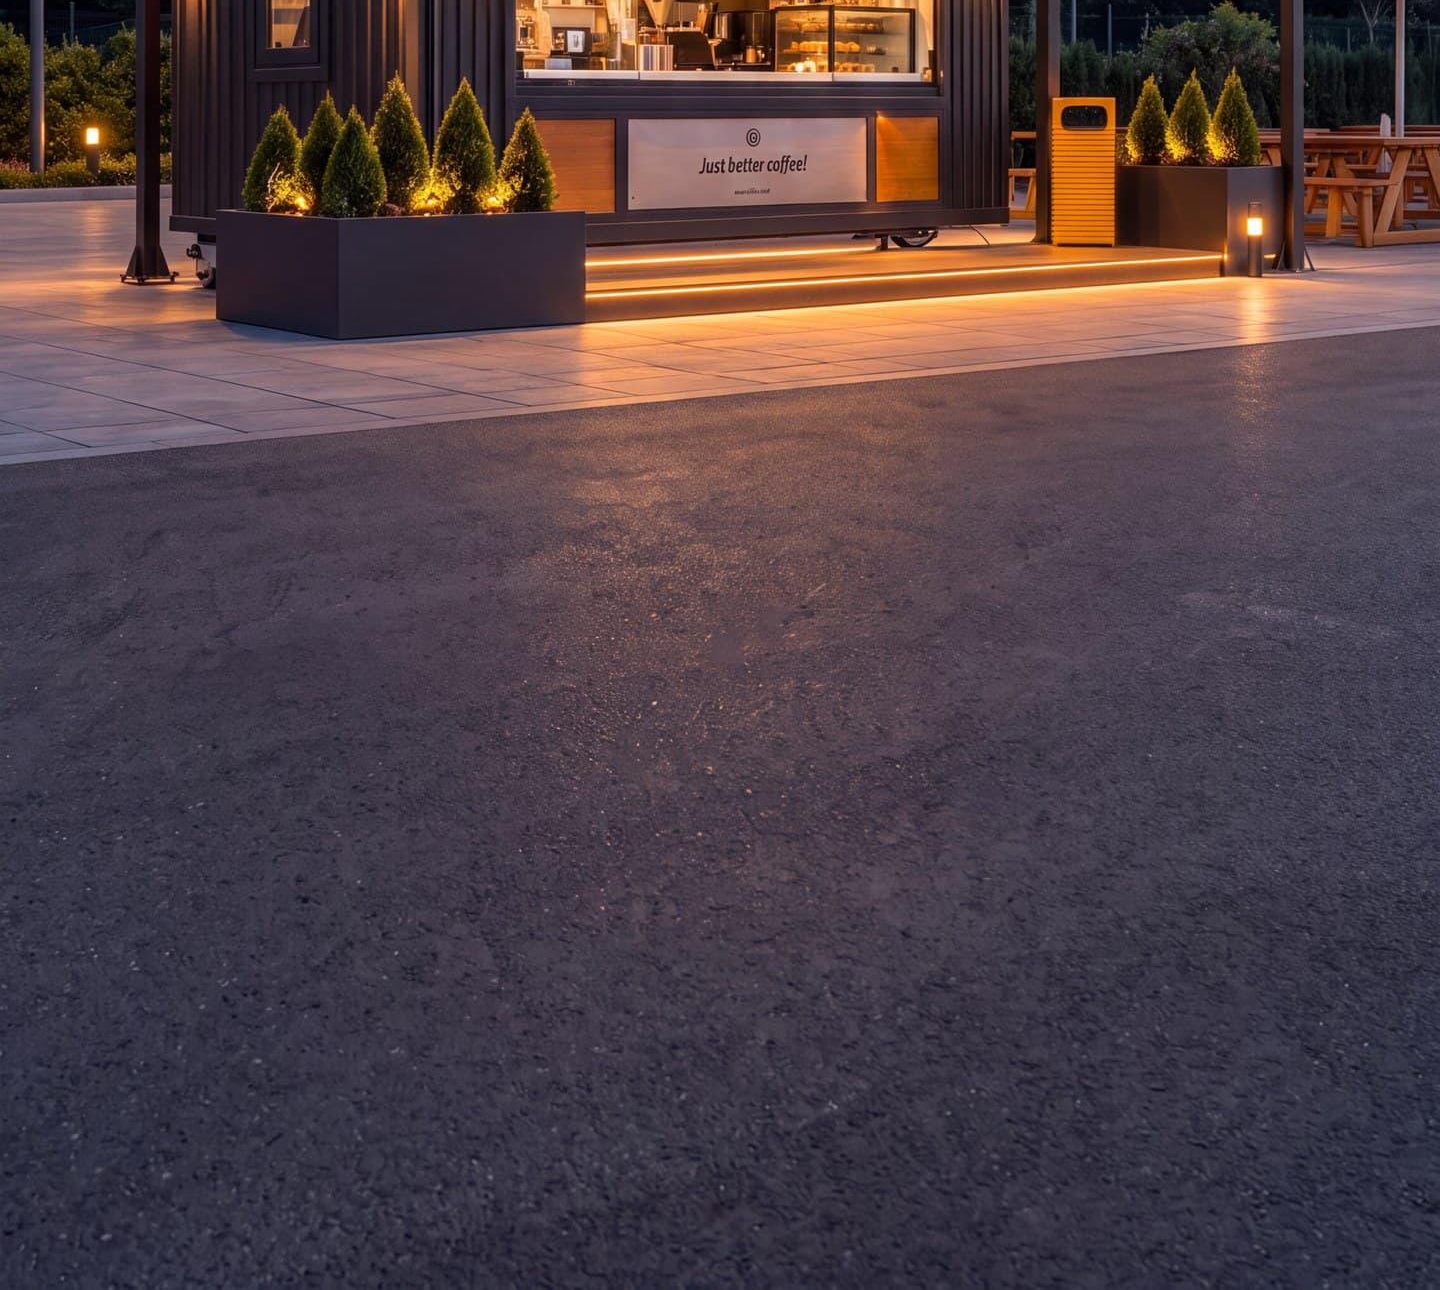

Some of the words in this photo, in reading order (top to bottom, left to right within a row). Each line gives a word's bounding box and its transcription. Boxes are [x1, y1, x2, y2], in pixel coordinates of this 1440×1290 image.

[698, 157, 726, 175] Just
[728, 156, 765, 173] better
[767, 154, 808, 175] coffee!
